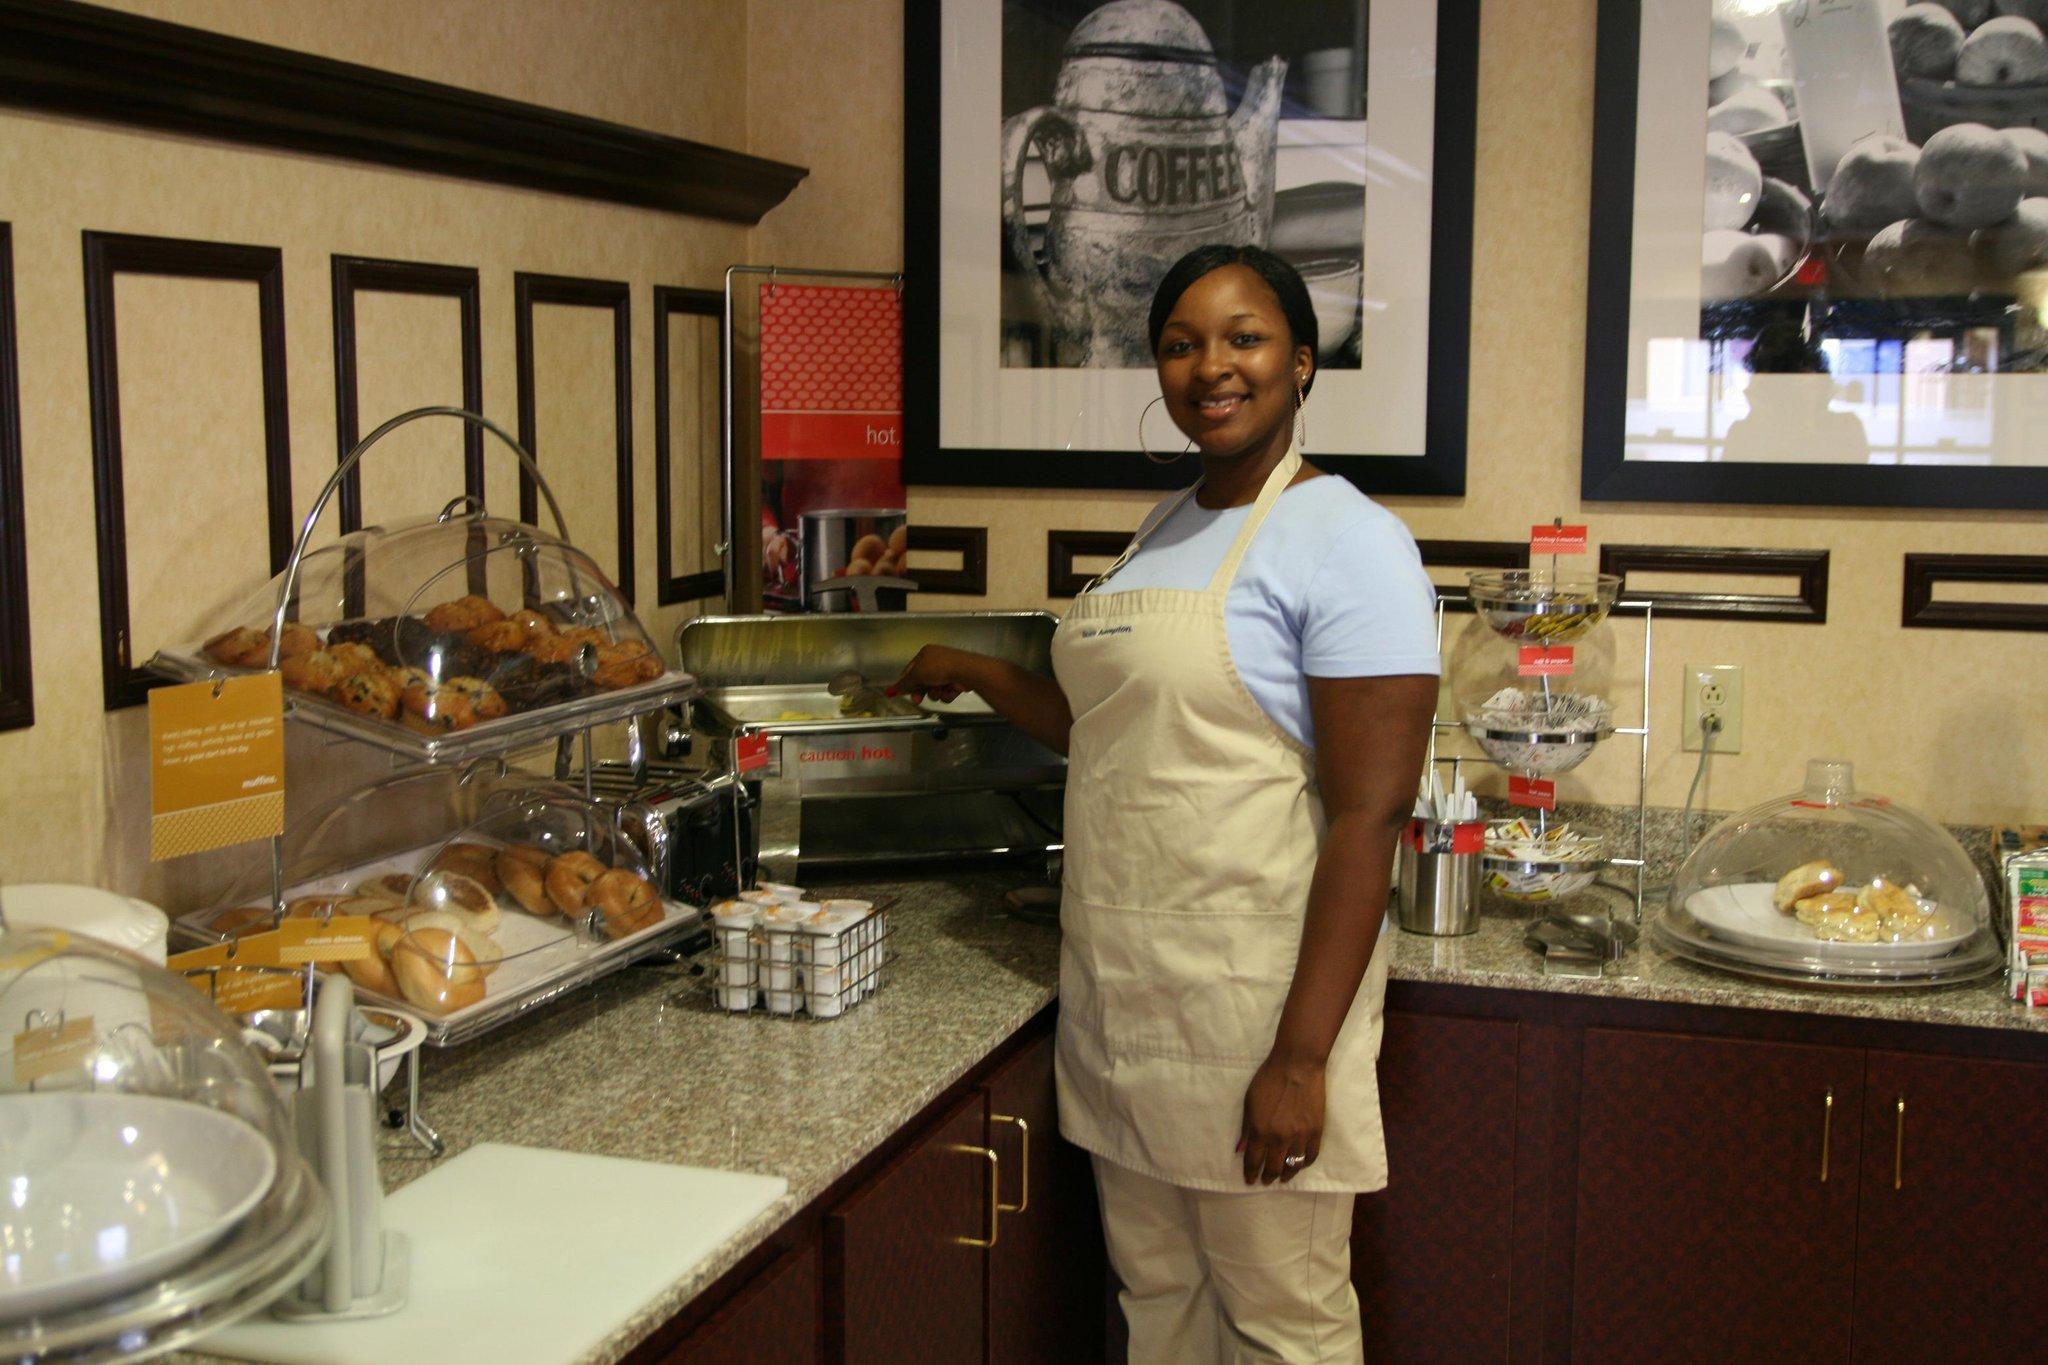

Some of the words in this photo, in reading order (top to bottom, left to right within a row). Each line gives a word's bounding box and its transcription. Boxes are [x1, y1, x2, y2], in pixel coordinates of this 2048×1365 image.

[1104, 145, 1245, 206] COFFEE
[866, 424, 901, 445] hot.
[799, 747, 855, 763] caution
